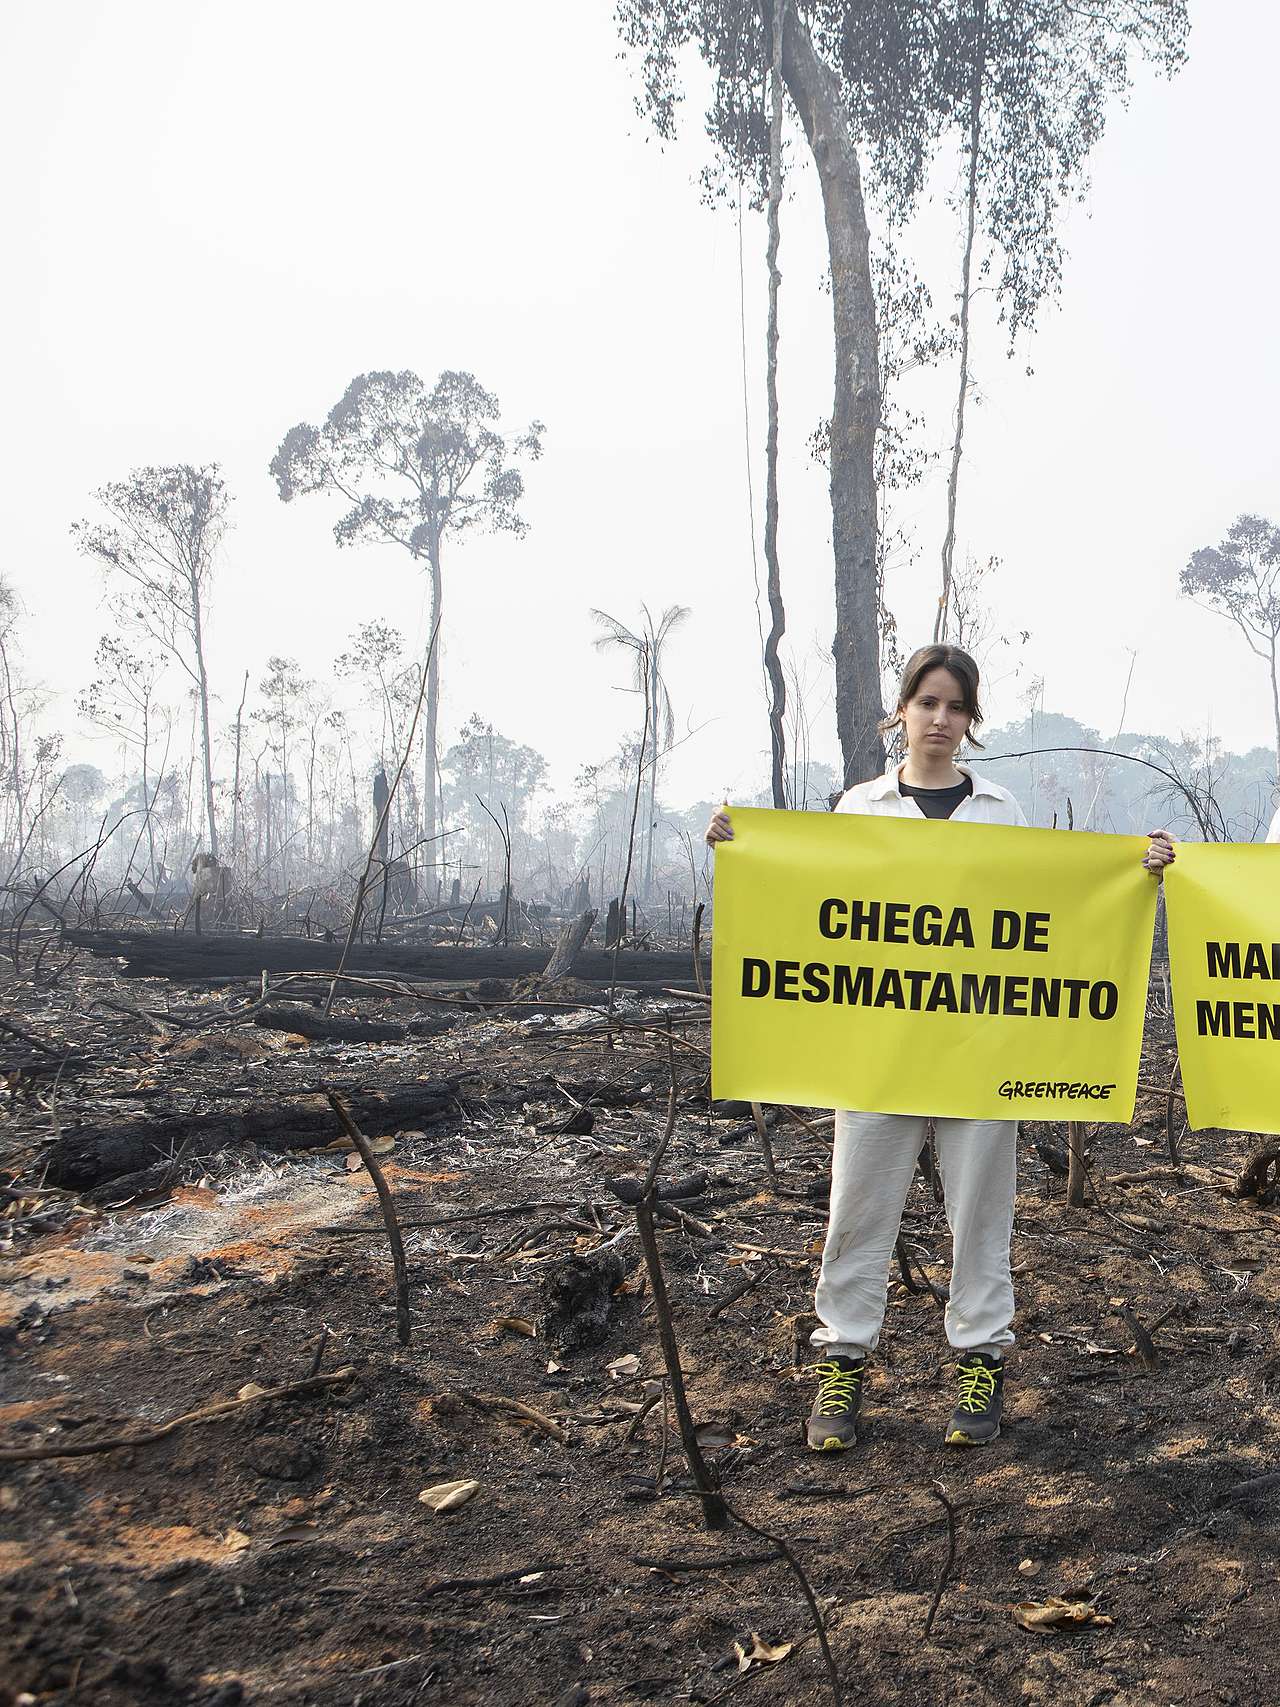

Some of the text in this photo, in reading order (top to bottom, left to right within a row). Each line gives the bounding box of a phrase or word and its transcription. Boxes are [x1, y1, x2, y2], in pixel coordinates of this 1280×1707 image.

[818, 898, 1051, 953] CHEGA DE
[741, 957, 1119, 1021] DESMATAMENTO
[998, 1080, 1117, 1101] GREENPEACE
